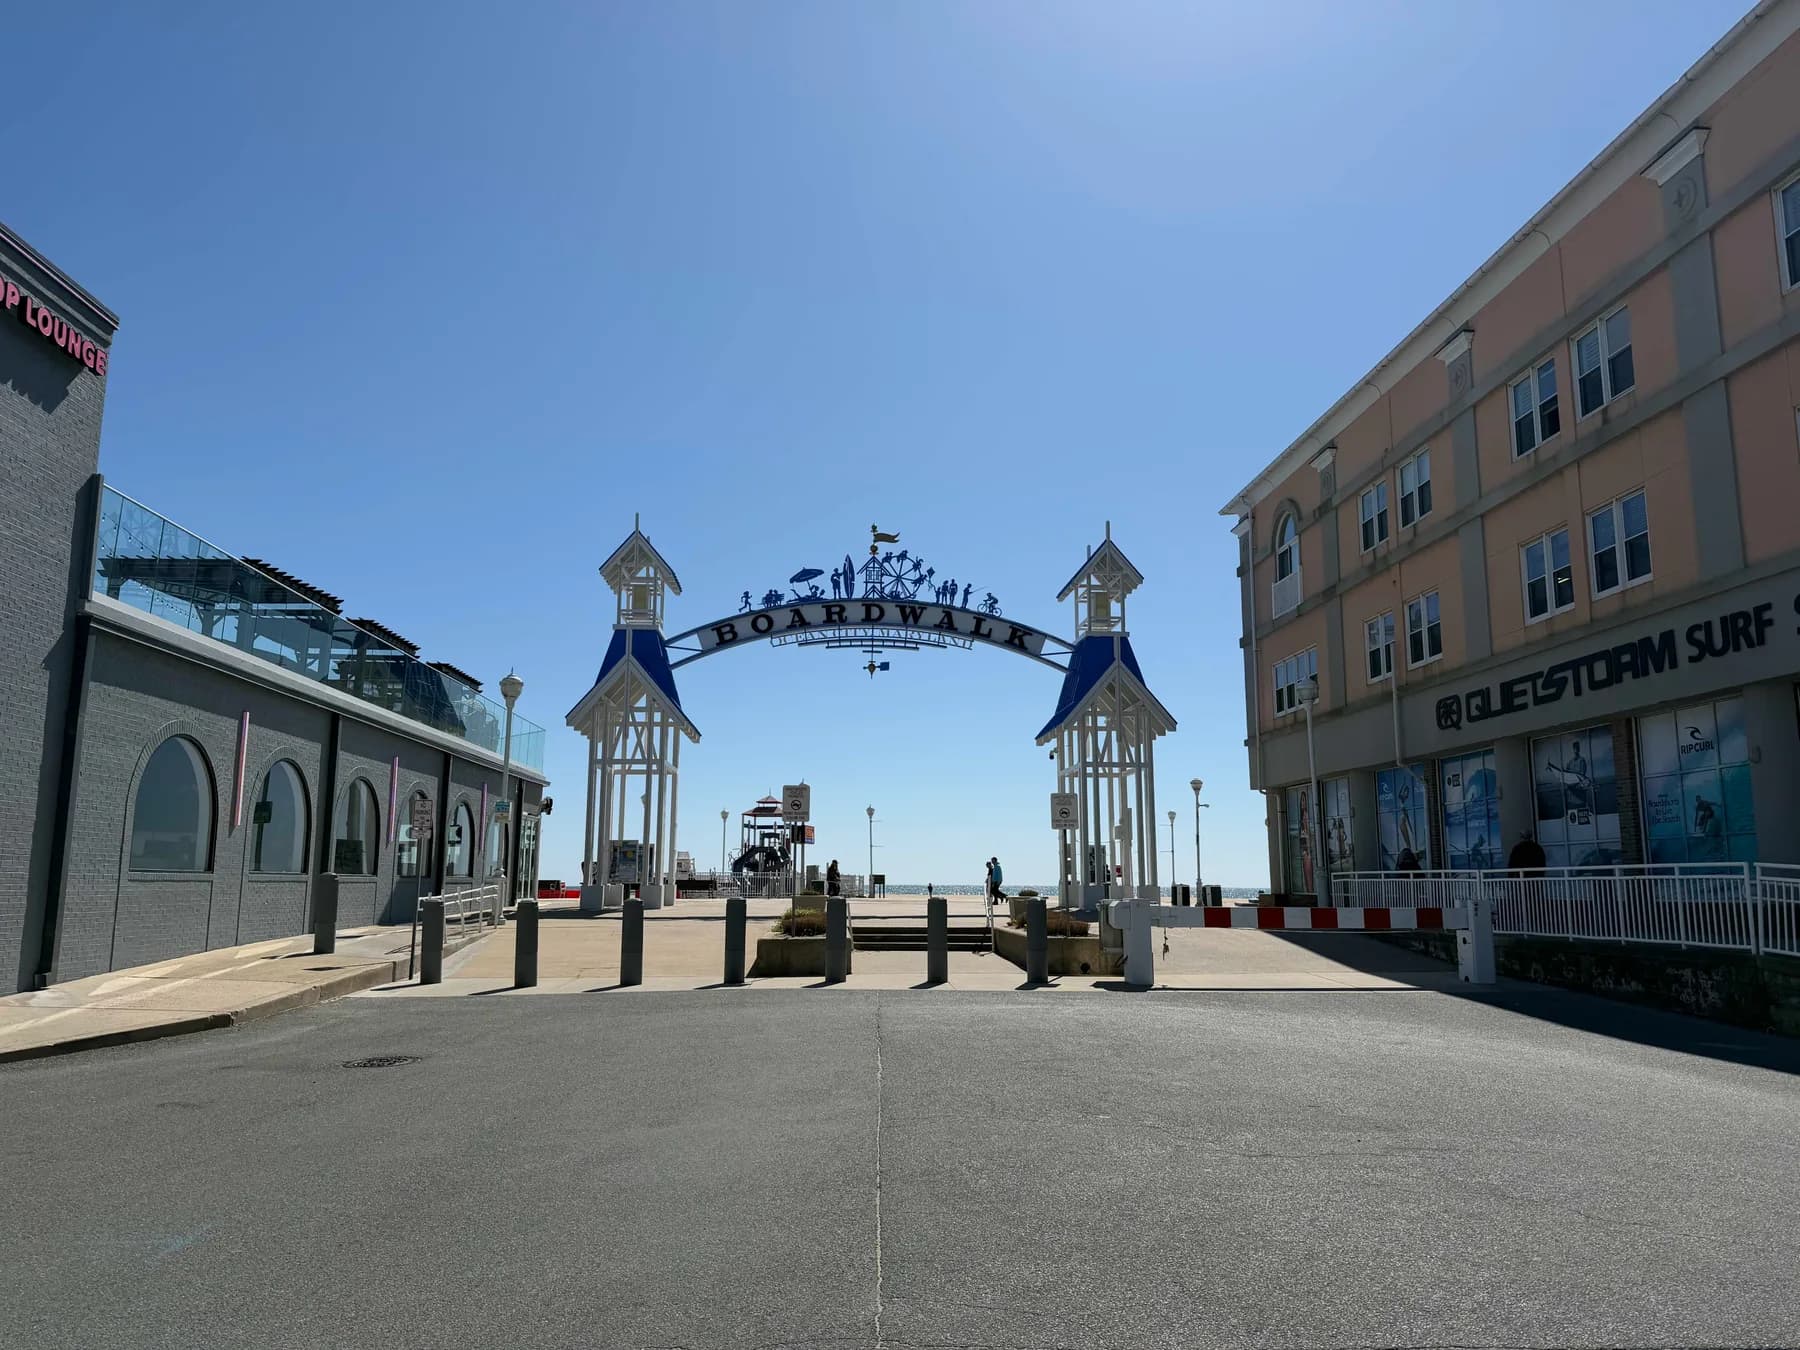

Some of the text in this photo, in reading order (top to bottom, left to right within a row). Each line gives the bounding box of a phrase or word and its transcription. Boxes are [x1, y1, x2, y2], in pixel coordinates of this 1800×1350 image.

[26, 296, 107, 376] LOUNGE
[710, 603, 1034, 650] BOARDWALK
[770, 630, 828, 647] OCEAN
[876, 628, 974, 650] MARYLAND
[1685, 602, 1774, 664] SURF
